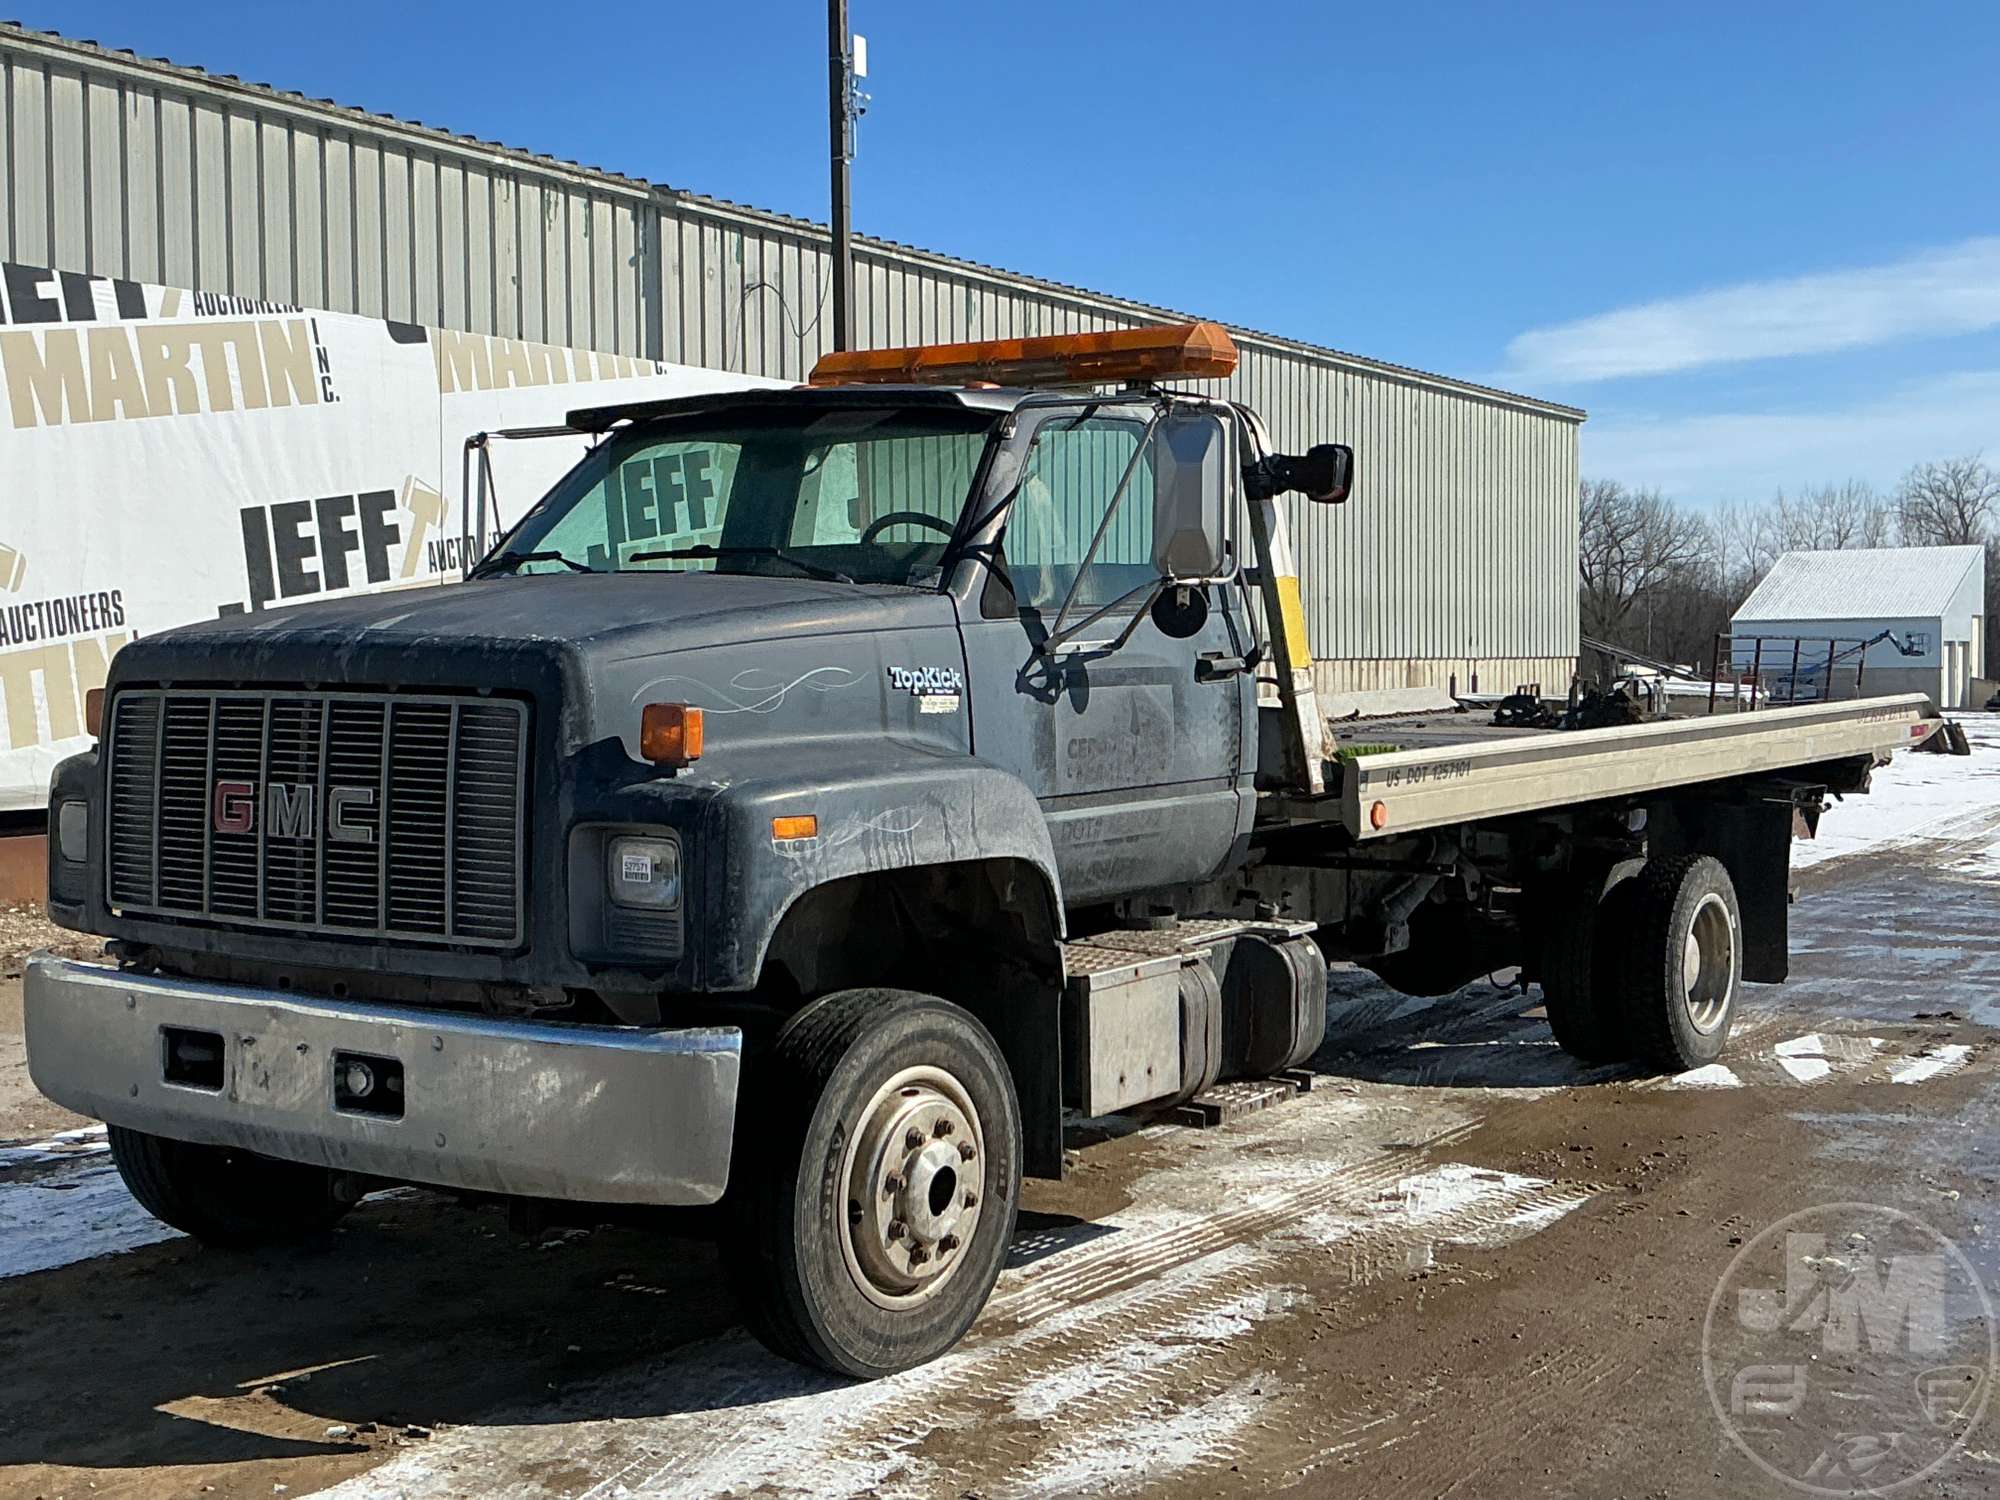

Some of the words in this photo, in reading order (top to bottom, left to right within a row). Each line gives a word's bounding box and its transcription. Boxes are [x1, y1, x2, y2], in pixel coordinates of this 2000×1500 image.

[0, 319, 319, 429] MARTIN
[218, 489, 400, 618] JEFF
[0, 589, 126, 647] AUCTIONEERS
[888, 667, 962, 694] TopKick
[1386, 769, 1401, 788] US
[1406, 765, 1428, 785] DOT
[213, 780, 376, 844] GMC
